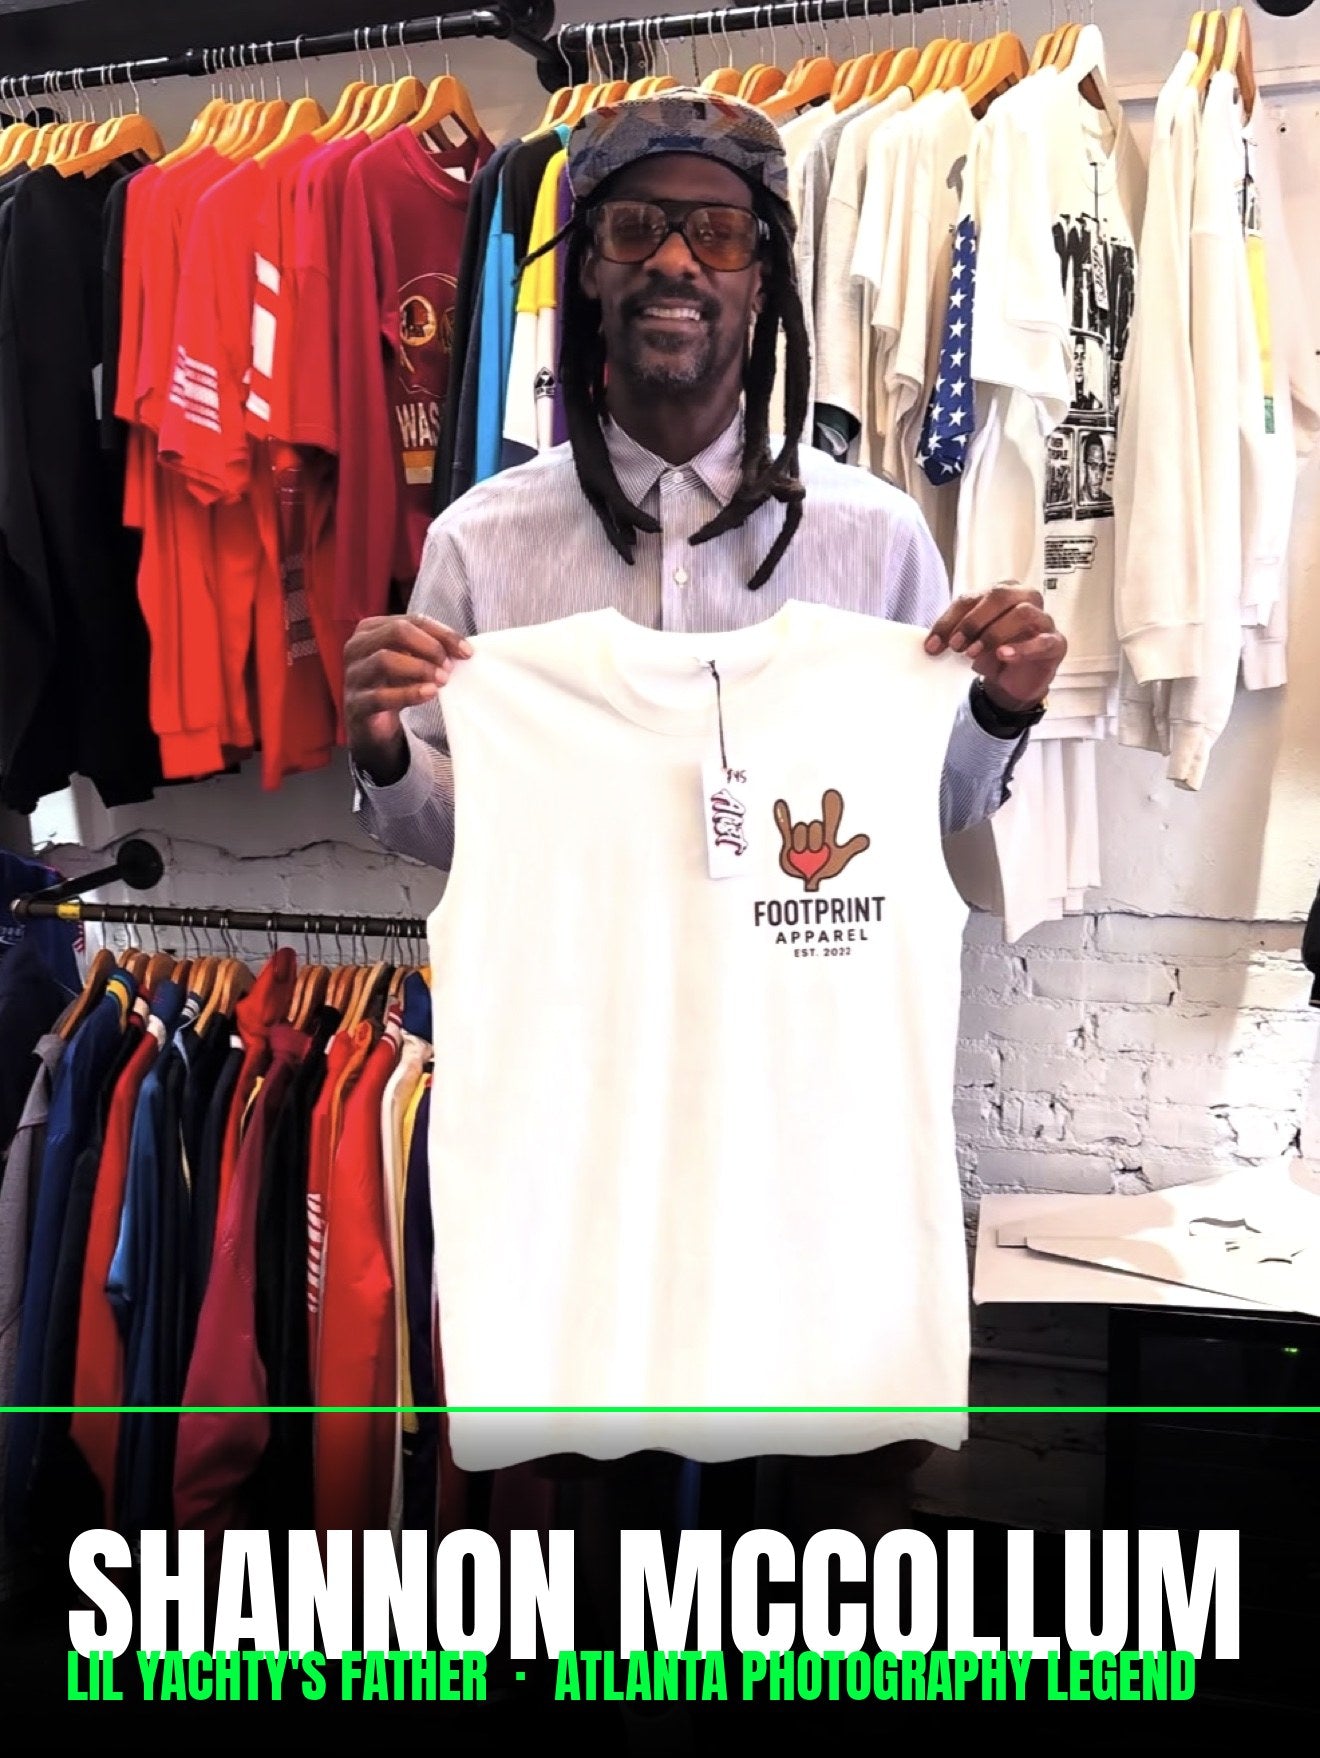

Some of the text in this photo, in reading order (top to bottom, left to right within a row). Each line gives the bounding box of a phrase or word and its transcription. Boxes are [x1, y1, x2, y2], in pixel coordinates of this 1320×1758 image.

[754, 896, 886, 926] FOOTPRINT
[775, 928, 868, 944] APPAREL
[794, 947, 851, 958] EST. 2022
